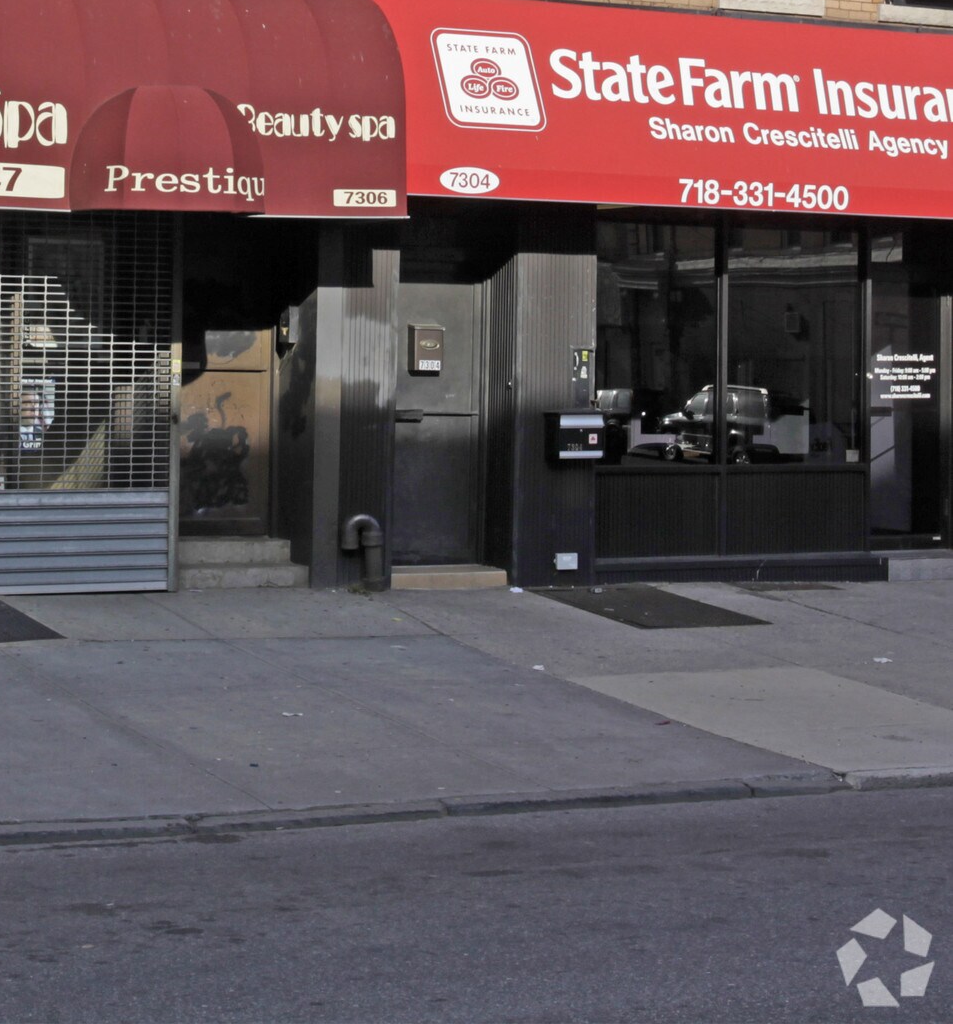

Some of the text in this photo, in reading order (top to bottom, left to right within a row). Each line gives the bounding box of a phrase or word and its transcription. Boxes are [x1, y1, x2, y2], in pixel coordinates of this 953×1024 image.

[446, 43, 518, 57] STATE FARM
[477, 65, 496, 77] Auto
[467, 81, 514, 95] Life Fire
[459, 104, 532, 118] INSURANCE
[348, 112, 396, 142] spa
[648, 117, 949, 160] Sharon Crescitelli Agency
[449, 172, 492, 189] 7304
[344, 190, 389, 205] 7306
[678, 179, 850, 212] 718-331-4500
